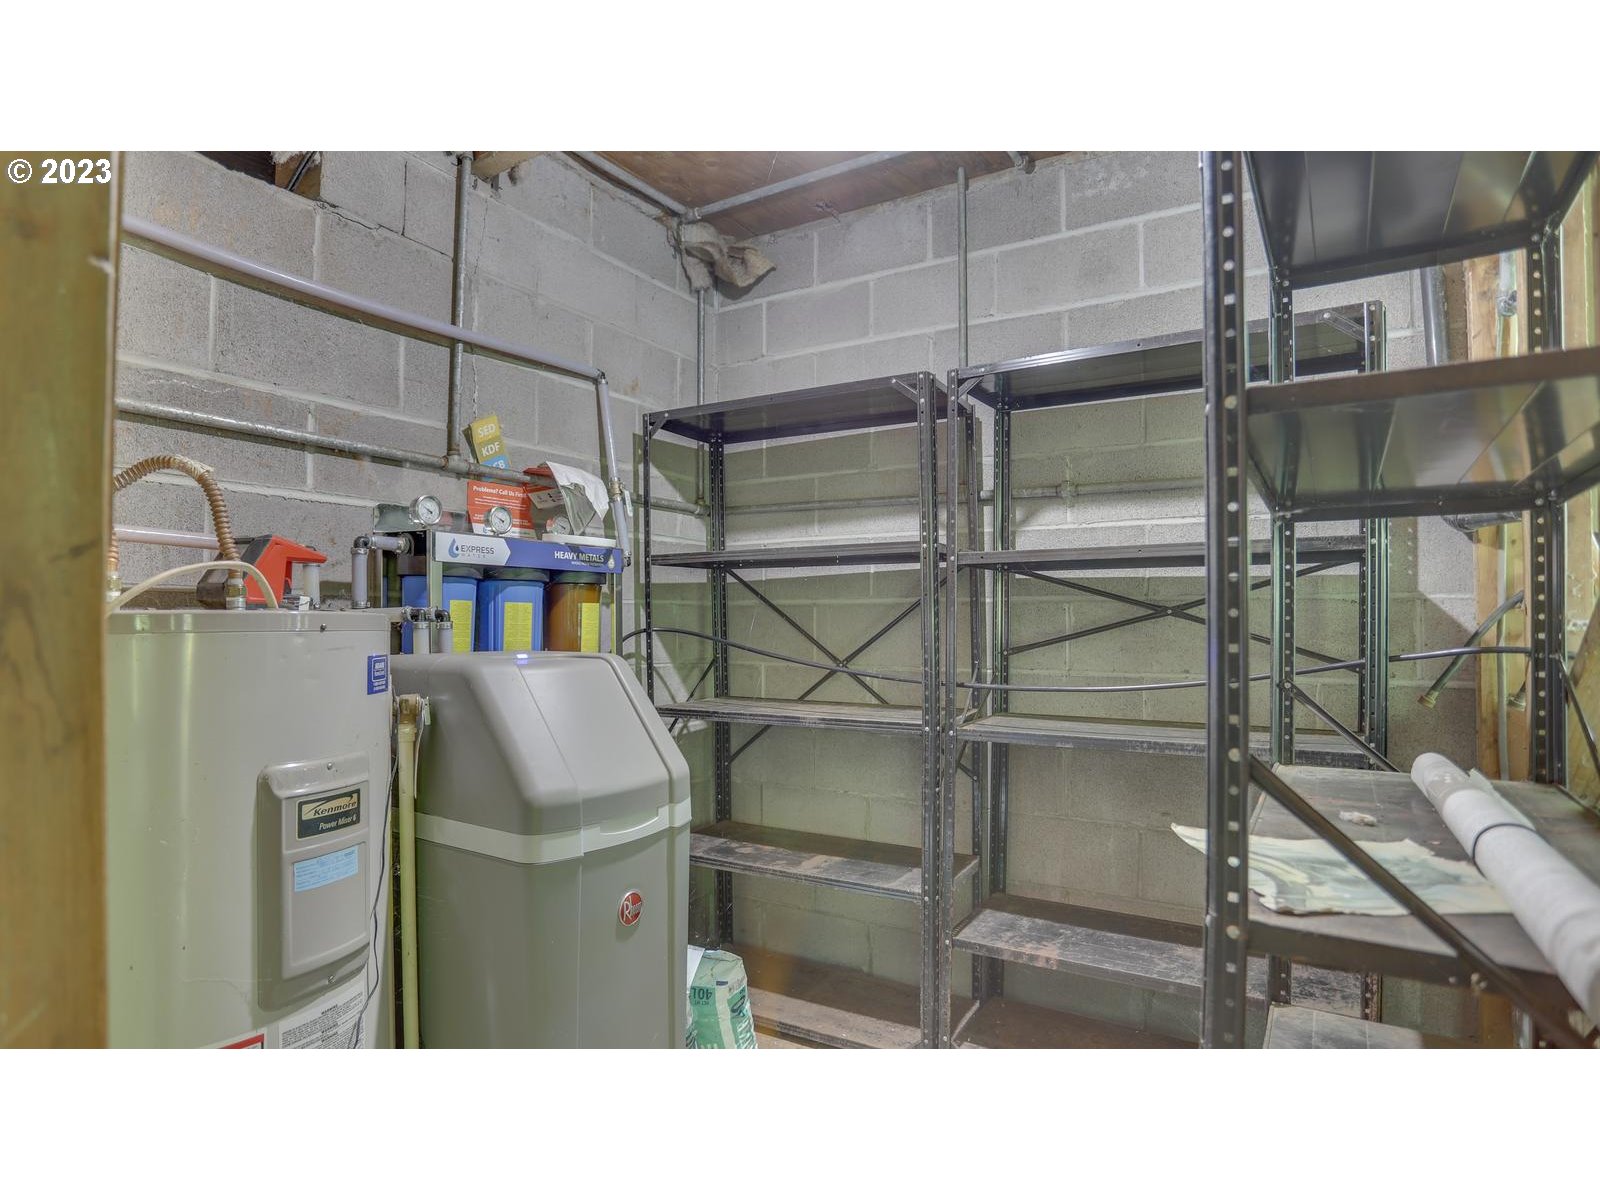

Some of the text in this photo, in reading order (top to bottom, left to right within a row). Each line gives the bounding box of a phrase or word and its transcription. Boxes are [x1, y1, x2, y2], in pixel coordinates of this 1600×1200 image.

[478, 423, 496, 437] SED
[481, 442, 501, 457] KDF
[472, 485, 499, 495] Problems?
[498, 488, 508, 496] Call
[460, 544, 495, 555] EXPRESS
[554, 550, 605, 563] HEAVY METALS
[312, 801, 357, 817] Kenmore
[318, 820, 338, 831] Power
[697, 988, 713, 1001] 40
